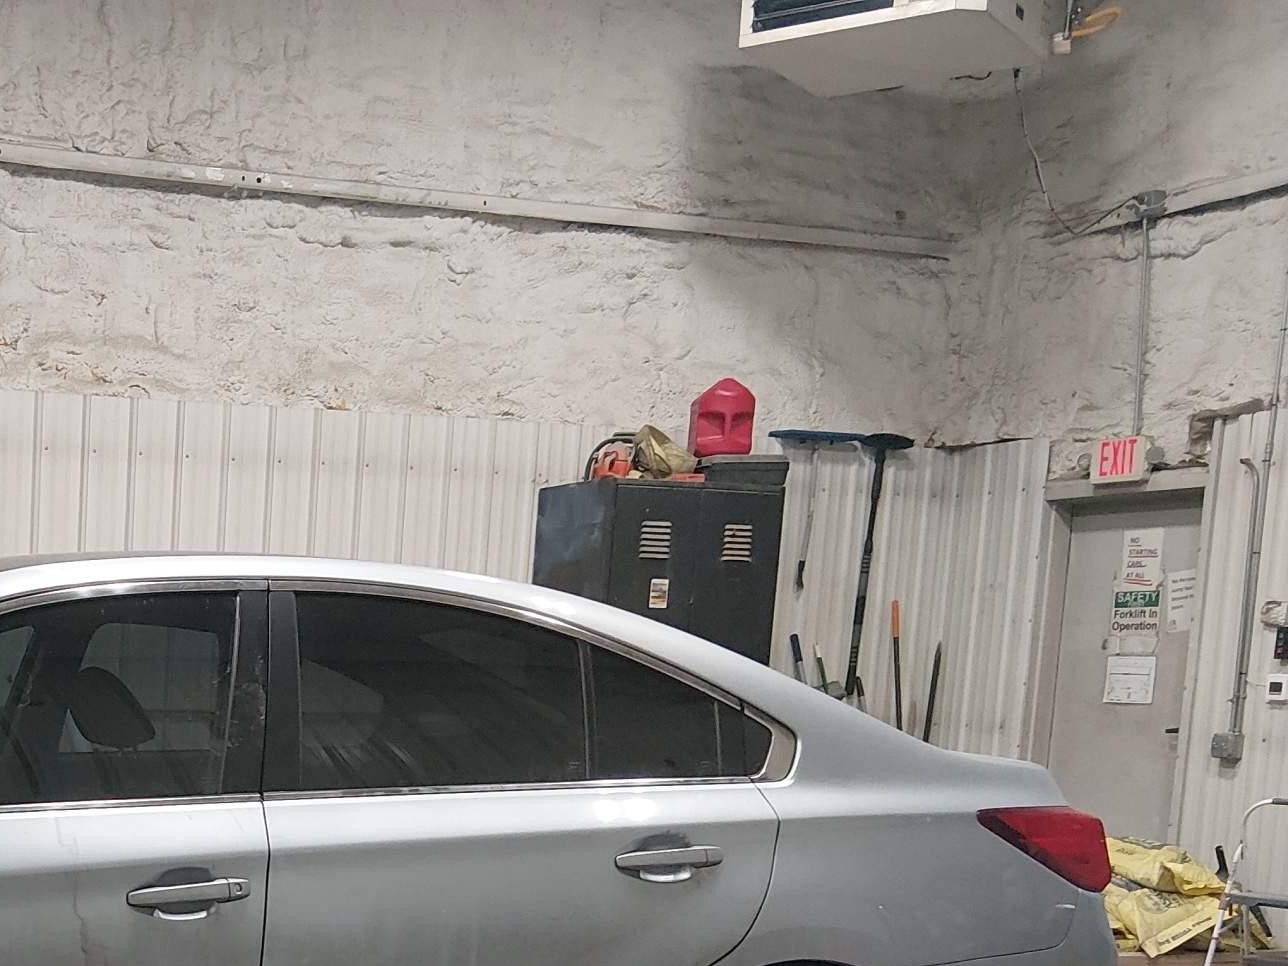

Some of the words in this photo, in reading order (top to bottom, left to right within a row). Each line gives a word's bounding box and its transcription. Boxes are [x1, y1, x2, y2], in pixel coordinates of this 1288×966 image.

[1099, 438, 1138, 477] EXIT
[1128, 548, 1158, 556] STARTING
[1116, 591, 1158, 603] SAFETY
[1114, 609, 1146, 619] Forklift
[1112, 621, 1158, 632] Operation
